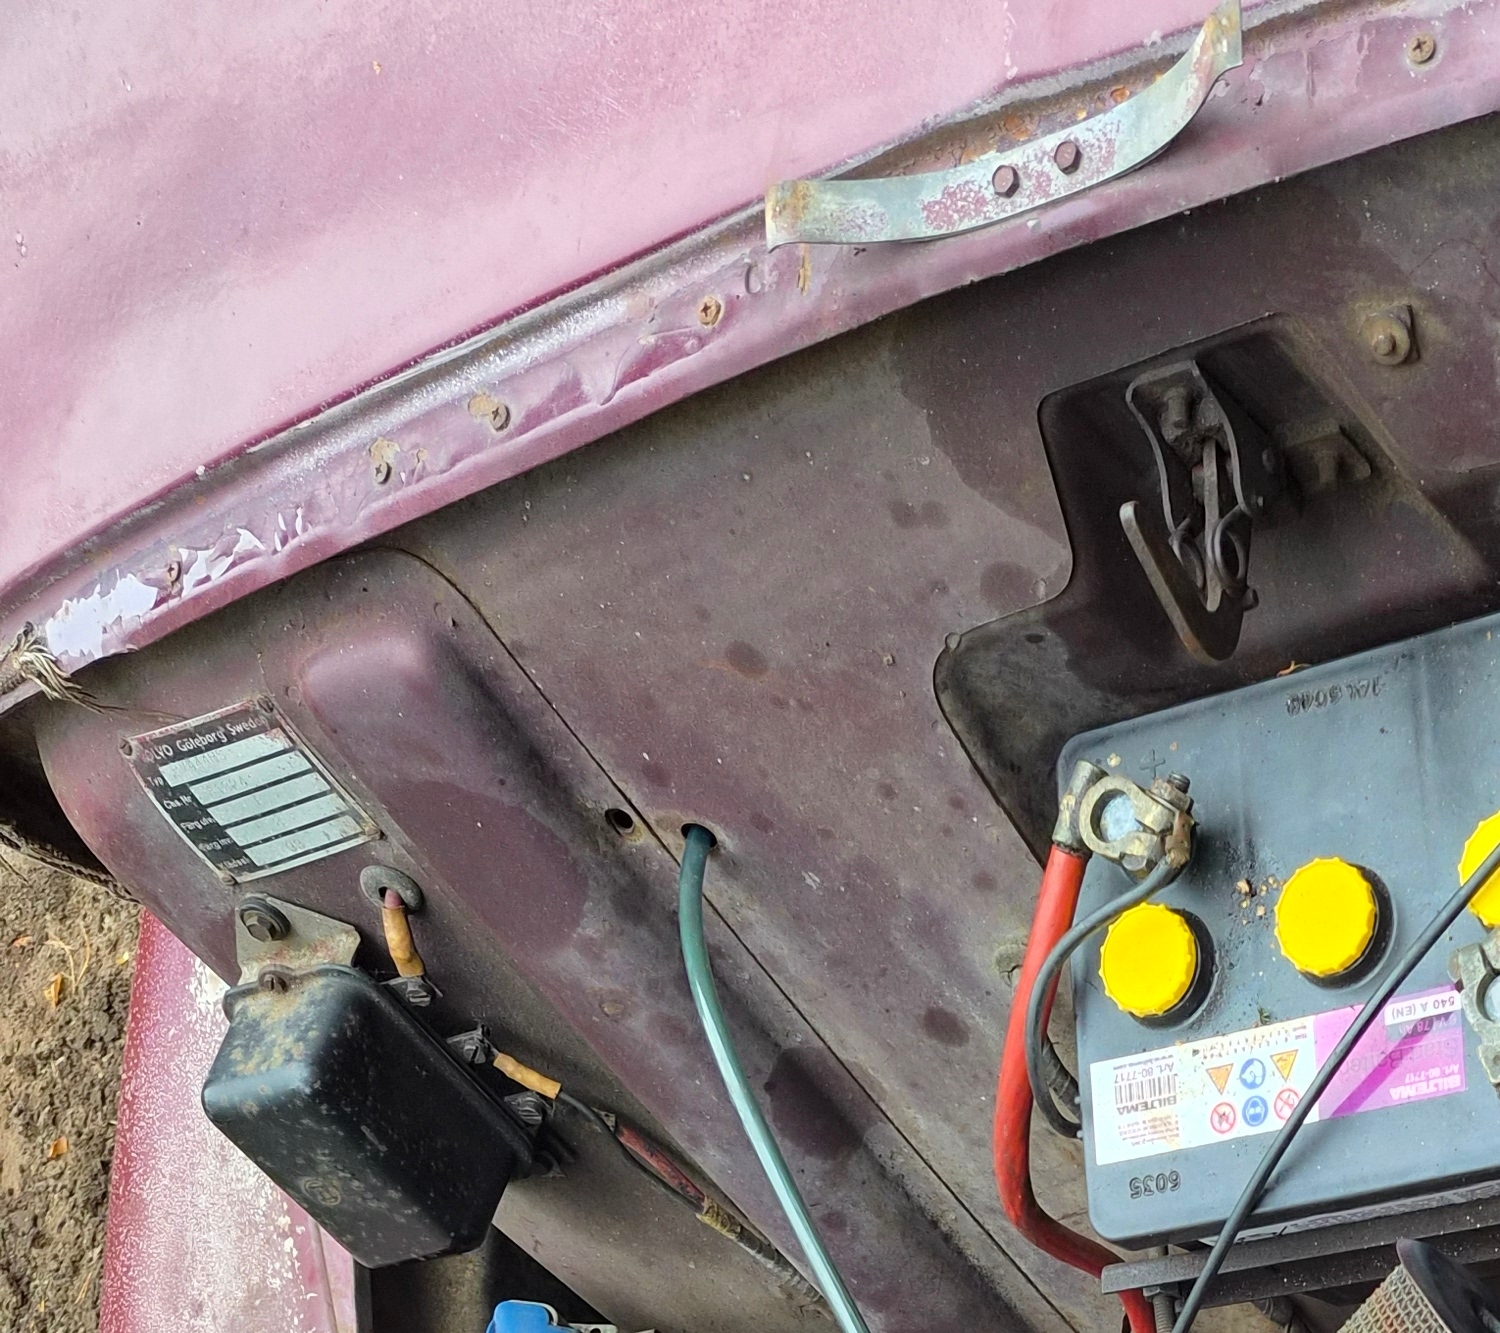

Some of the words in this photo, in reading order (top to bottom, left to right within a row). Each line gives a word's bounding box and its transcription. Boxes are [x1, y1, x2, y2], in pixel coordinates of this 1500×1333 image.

[176, 725, 228, 752] Göteborg
[1392, 1003, 1416, 1020] (EN)
[1421, 1002, 1429, 1012] A
[1433, 996, 1455, 1010] 540
[1417, 1020, 1430, 1033] 78
[1114, 1065, 1154, 1084] 80-7717
[1154, 1061, 1174, 1074] Art.
[1389, 1074, 1461, 1101] BILTEMA
[1117, 1095, 1177, 1115] BILTEMA
[1129, 1170, 1181, 1200] 6035
